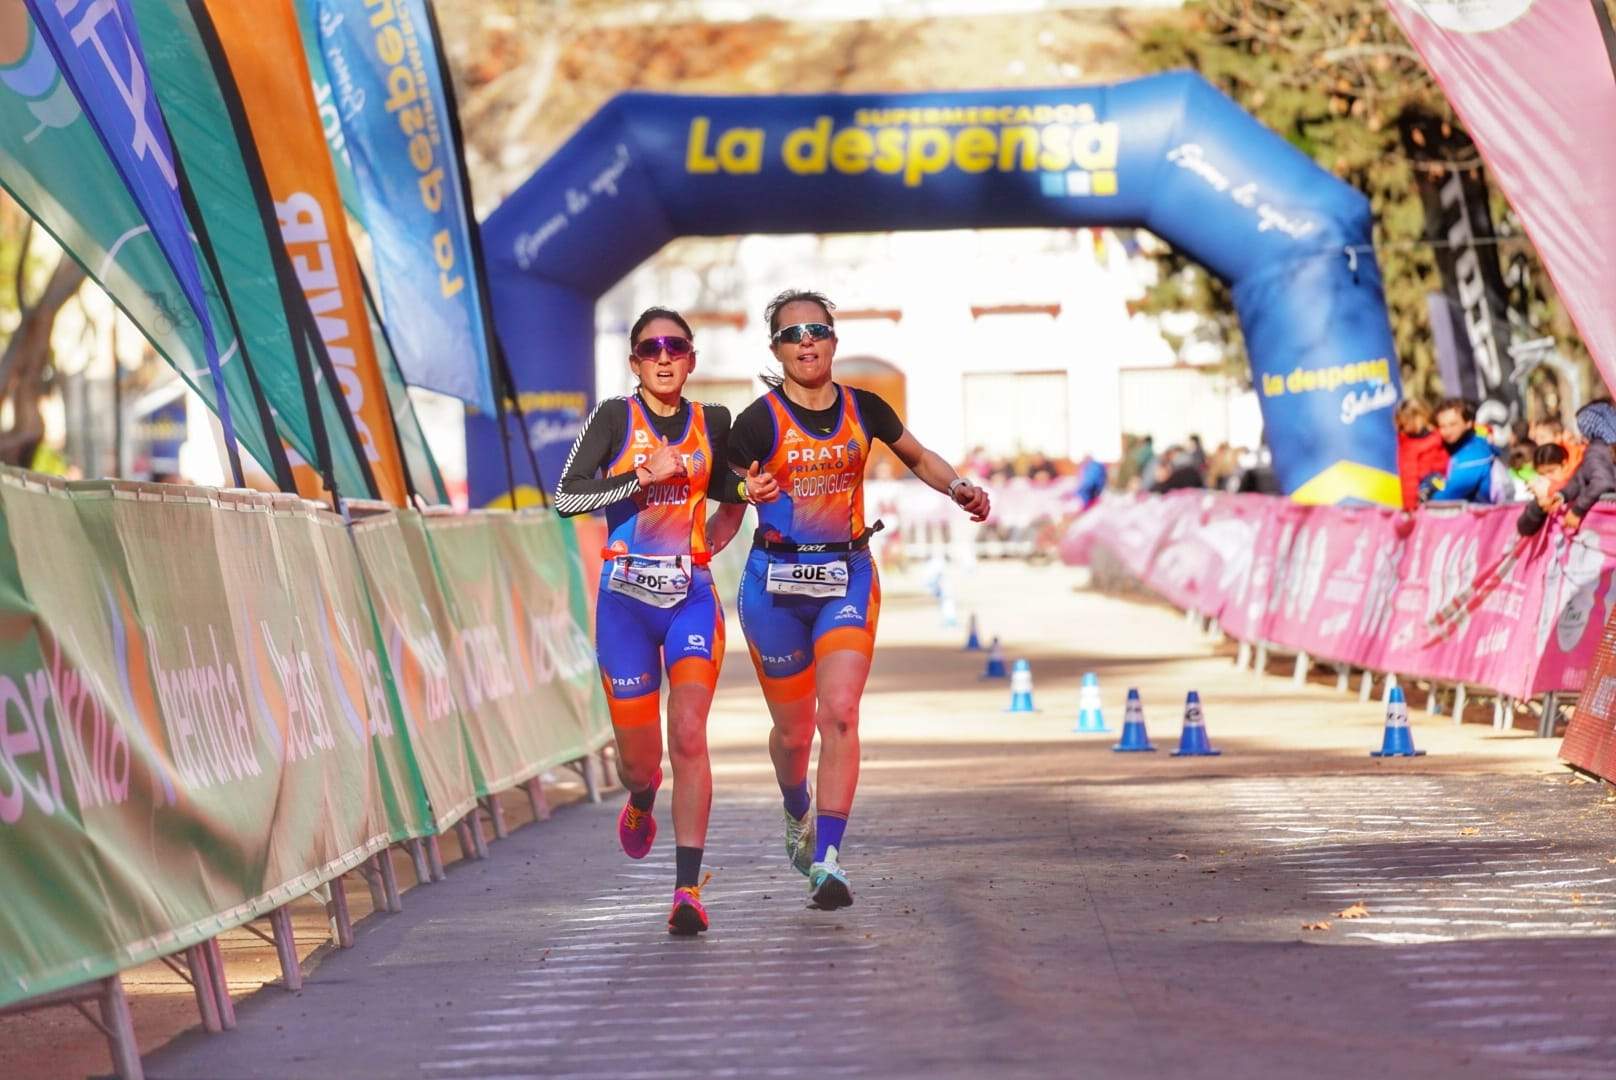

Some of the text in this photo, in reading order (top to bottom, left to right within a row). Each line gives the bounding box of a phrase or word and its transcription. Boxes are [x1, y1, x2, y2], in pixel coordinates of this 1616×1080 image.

[854, 103, 1096, 127] SUPERMERCADOS
[685, 112, 1120, 187] La despensa
[787, 444, 845, 464] PRAT
[645, 484, 690, 506] PUYALS
[612, 676, 641, 687] PRAT
